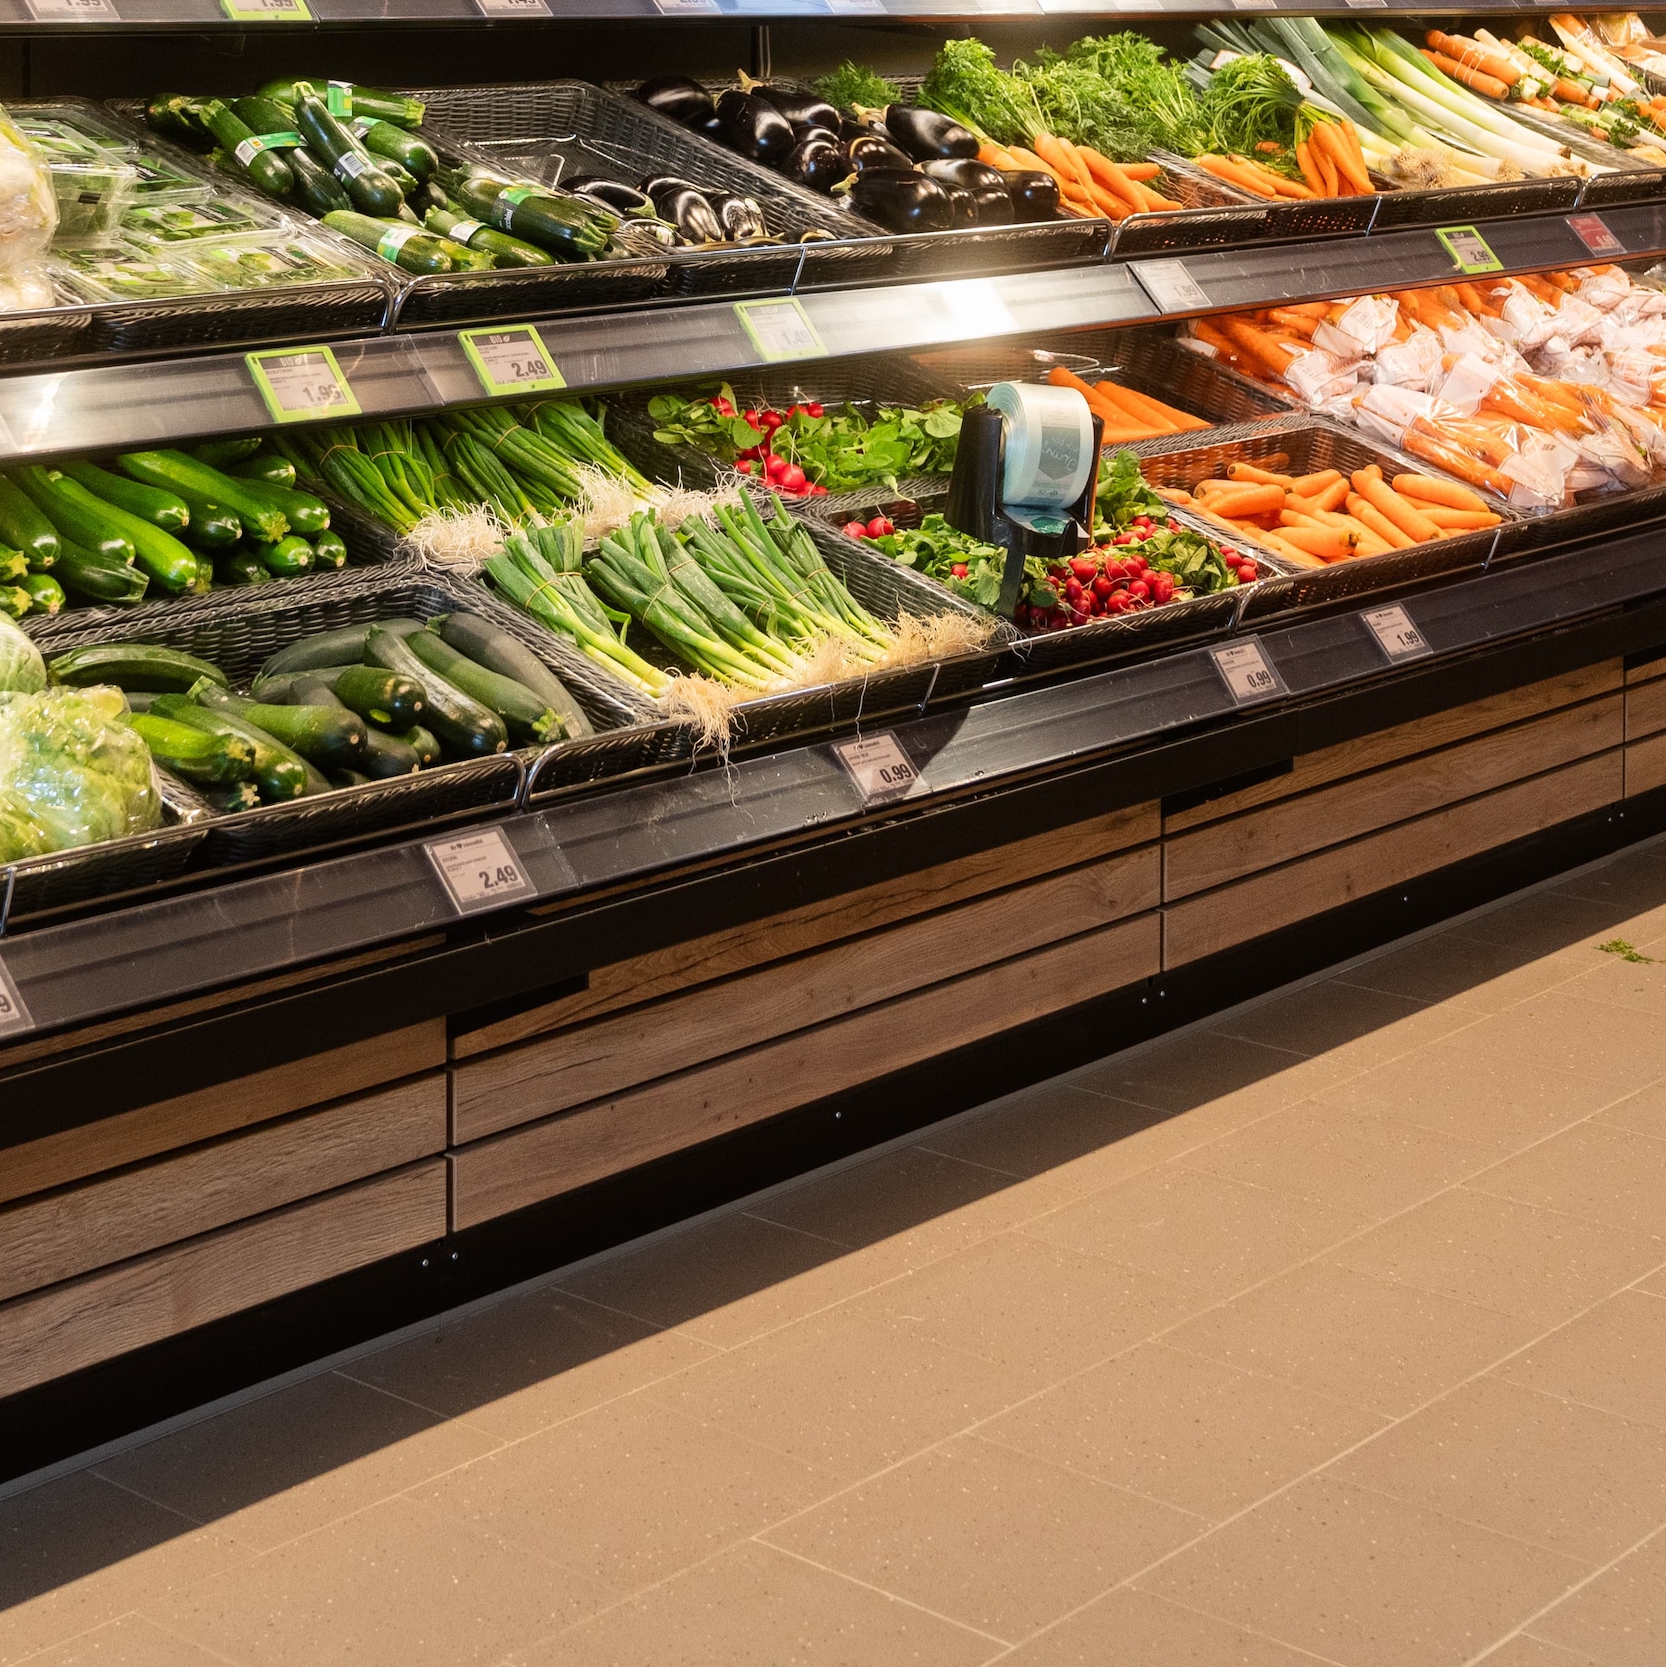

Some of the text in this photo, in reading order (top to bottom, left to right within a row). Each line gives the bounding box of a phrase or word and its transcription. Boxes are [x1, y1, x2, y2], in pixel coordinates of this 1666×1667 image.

[780, 328, 810, 348] 1.49
[511, 359, 547, 381] 2.49
[1393, 630, 1419, 649] 1.99
[1246, 668, 1274, 689] 0.99
[879, 762, 912, 785] 0.99
[478, 864, 519, 891] 2.49
